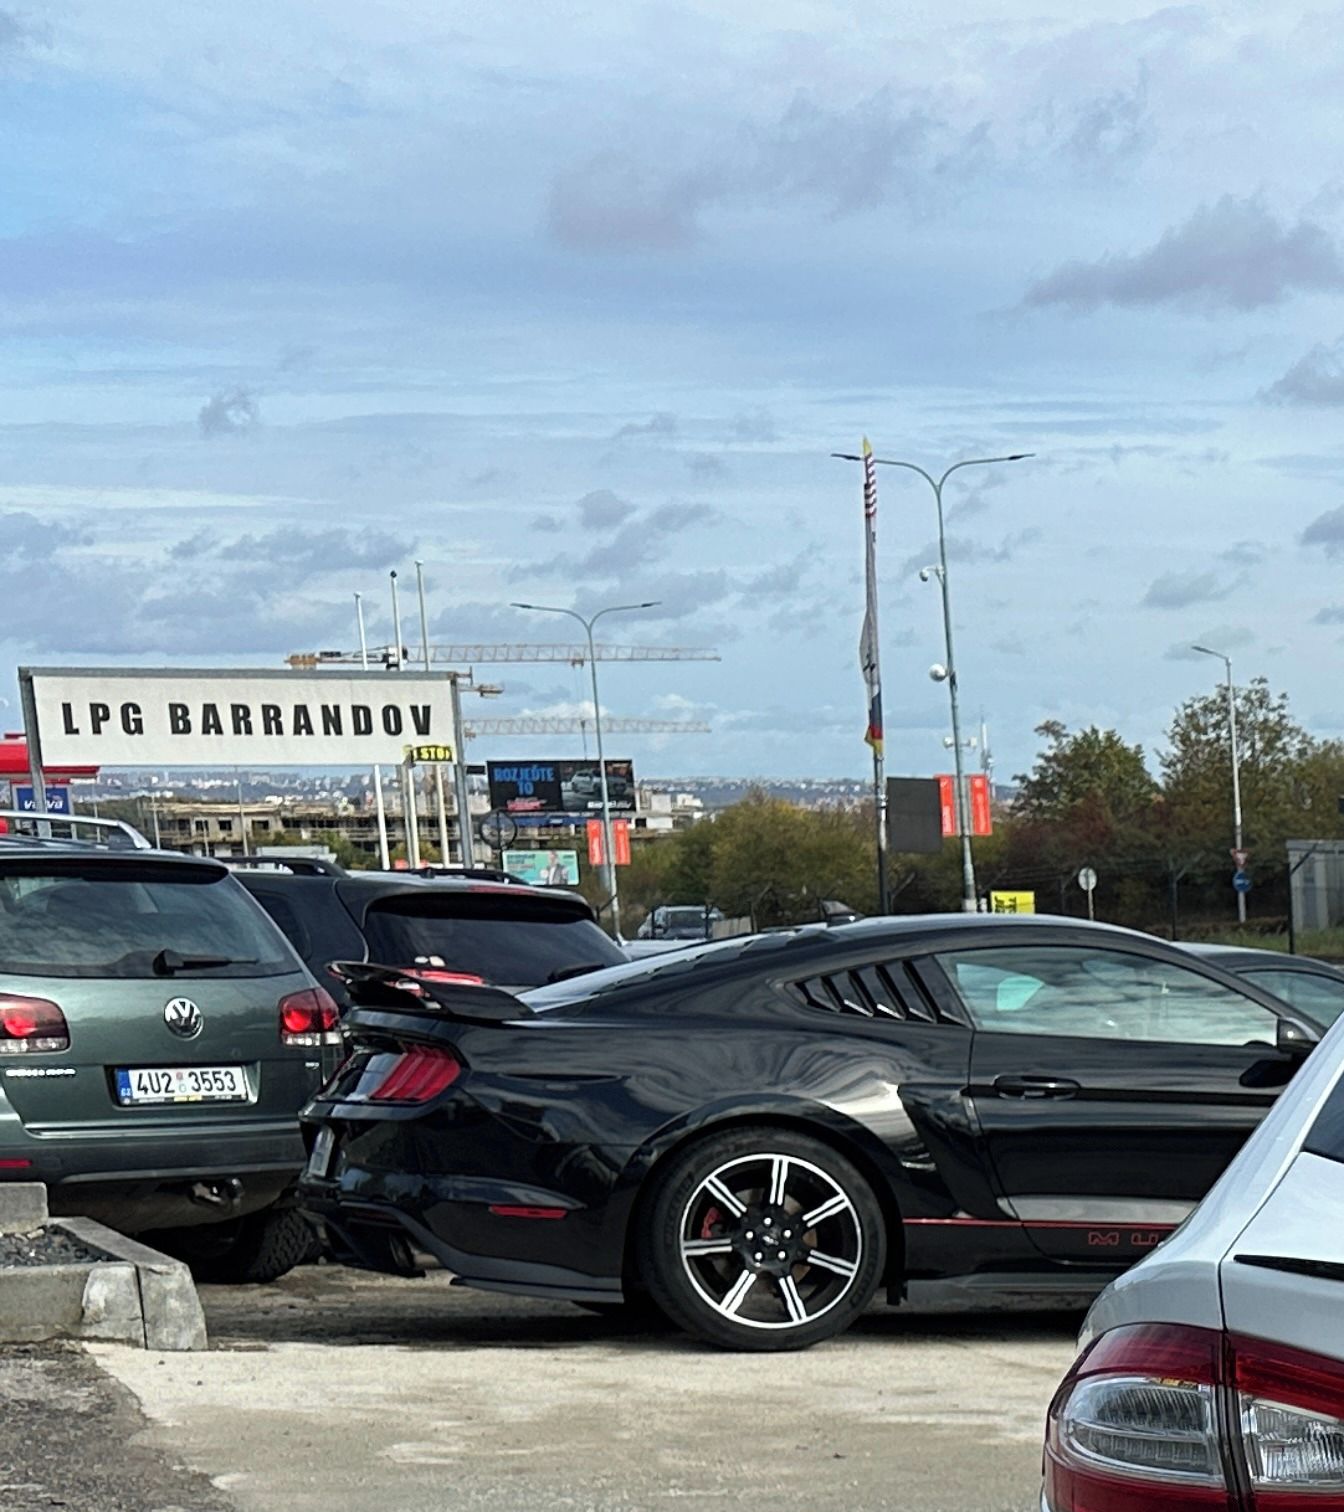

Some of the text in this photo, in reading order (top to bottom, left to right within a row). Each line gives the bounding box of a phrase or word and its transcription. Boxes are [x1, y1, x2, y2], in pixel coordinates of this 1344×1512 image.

[62, 702, 432, 736] LPG BARRANDOV
[137, 1071, 176, 1095] 4U2
[188, 1070, 236, 1092] 3553
